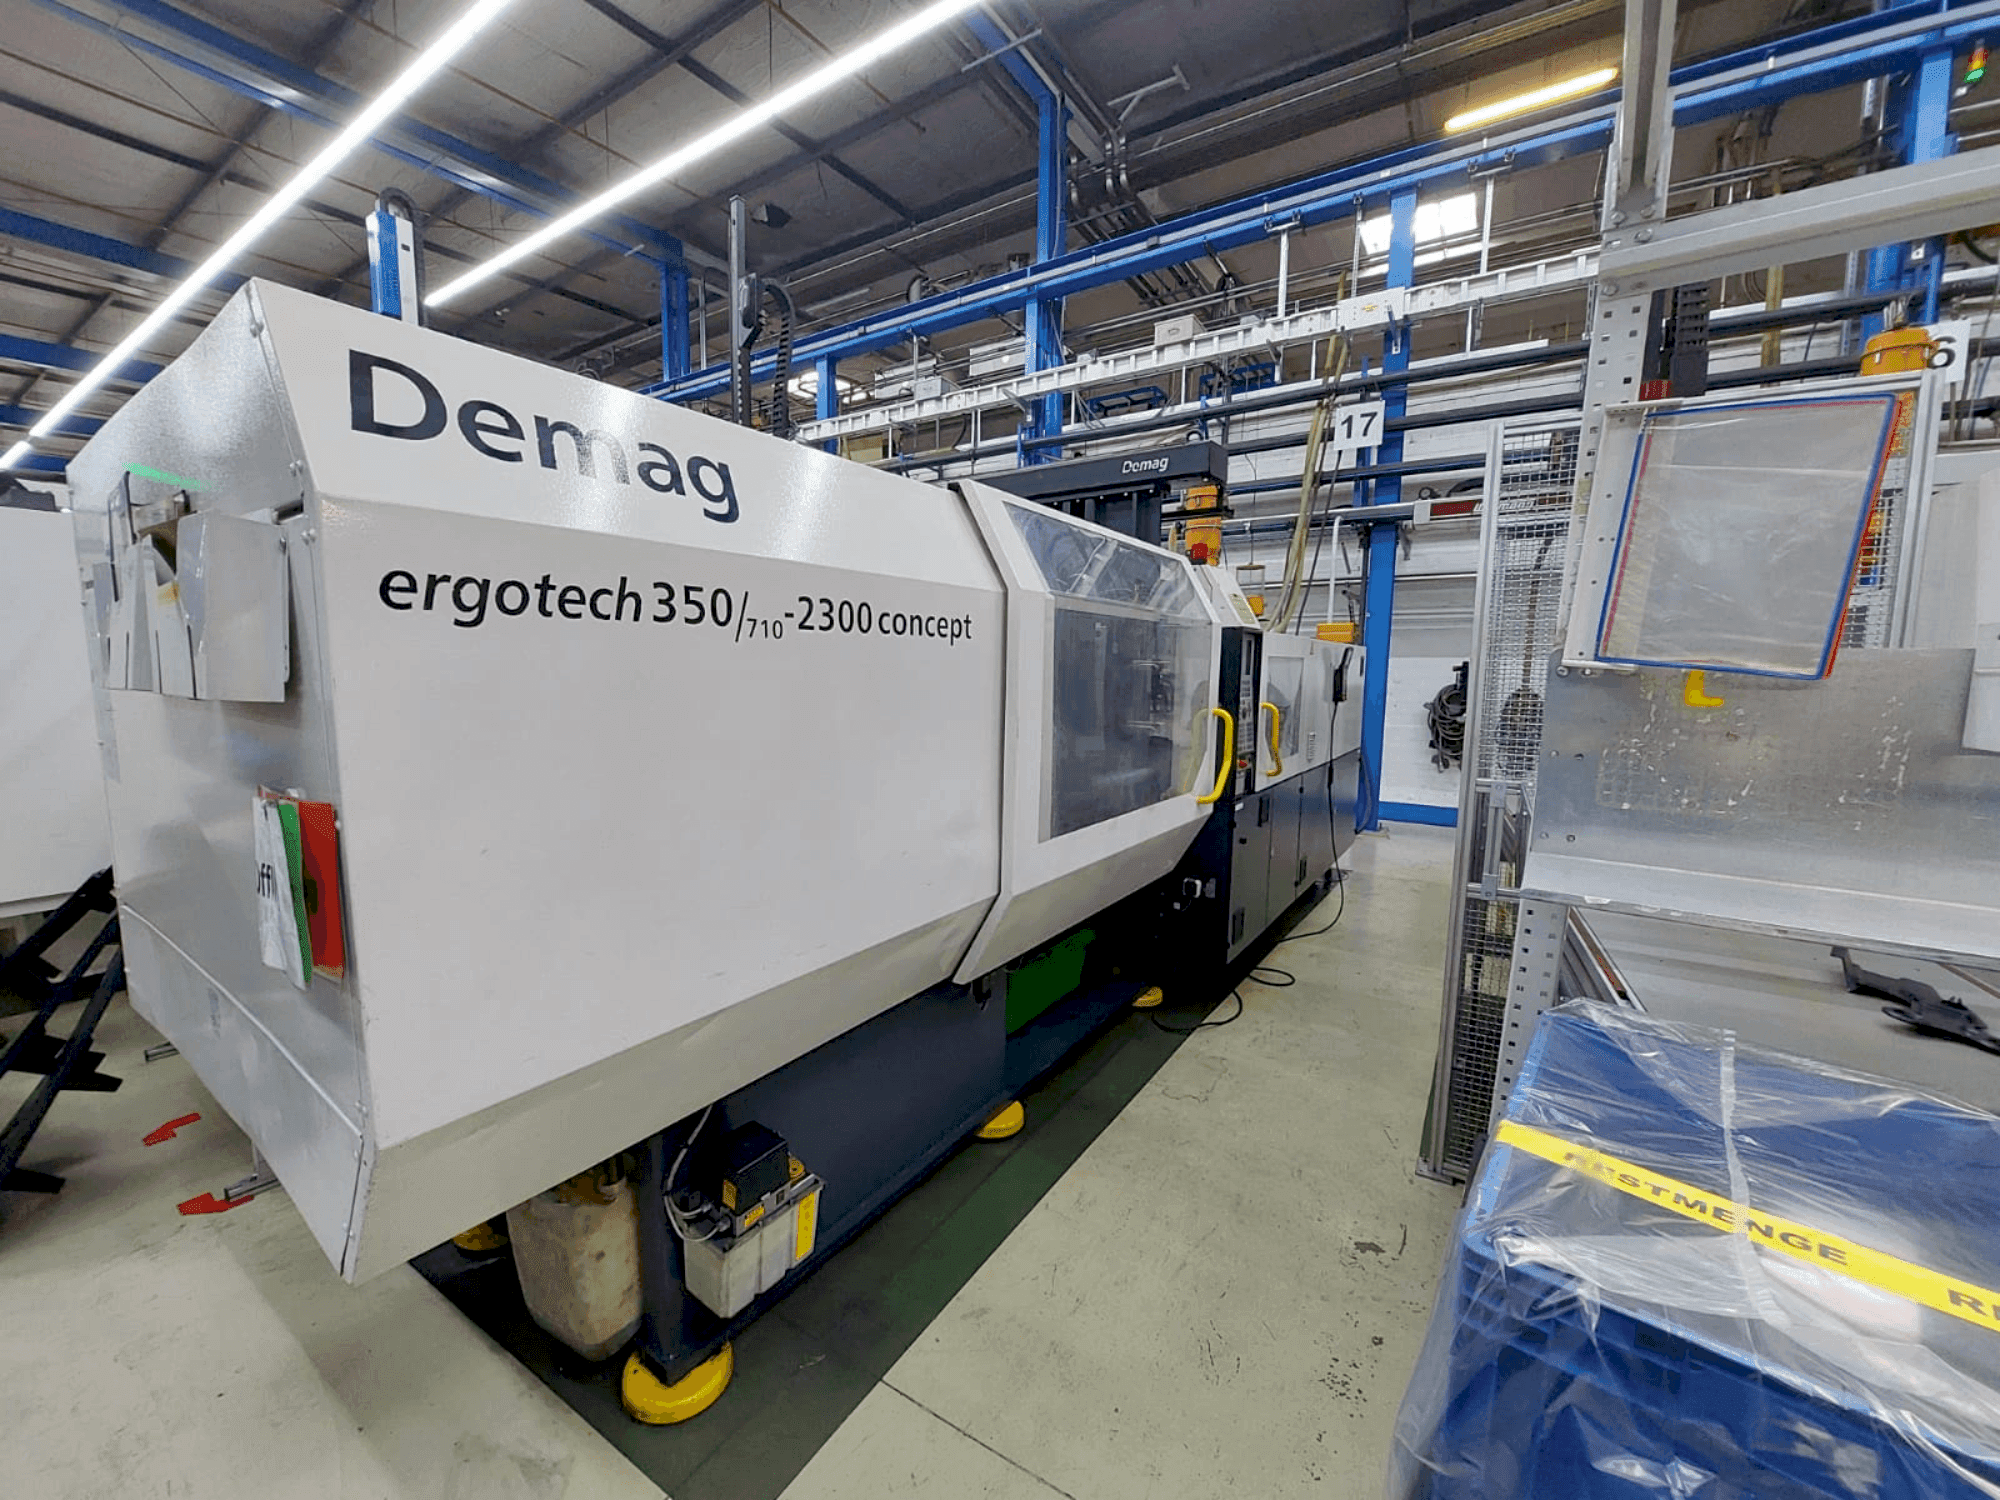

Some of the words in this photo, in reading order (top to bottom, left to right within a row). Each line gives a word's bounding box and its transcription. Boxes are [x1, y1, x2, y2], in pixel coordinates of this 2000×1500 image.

[349, 348, 740, 524] Demag
[1340, 410, 1379, 440] 17
[1121, 456, 1170, 474] Demag
[378, 569, 643, 628] ergotech
[878, 610, 973, 646] concept
